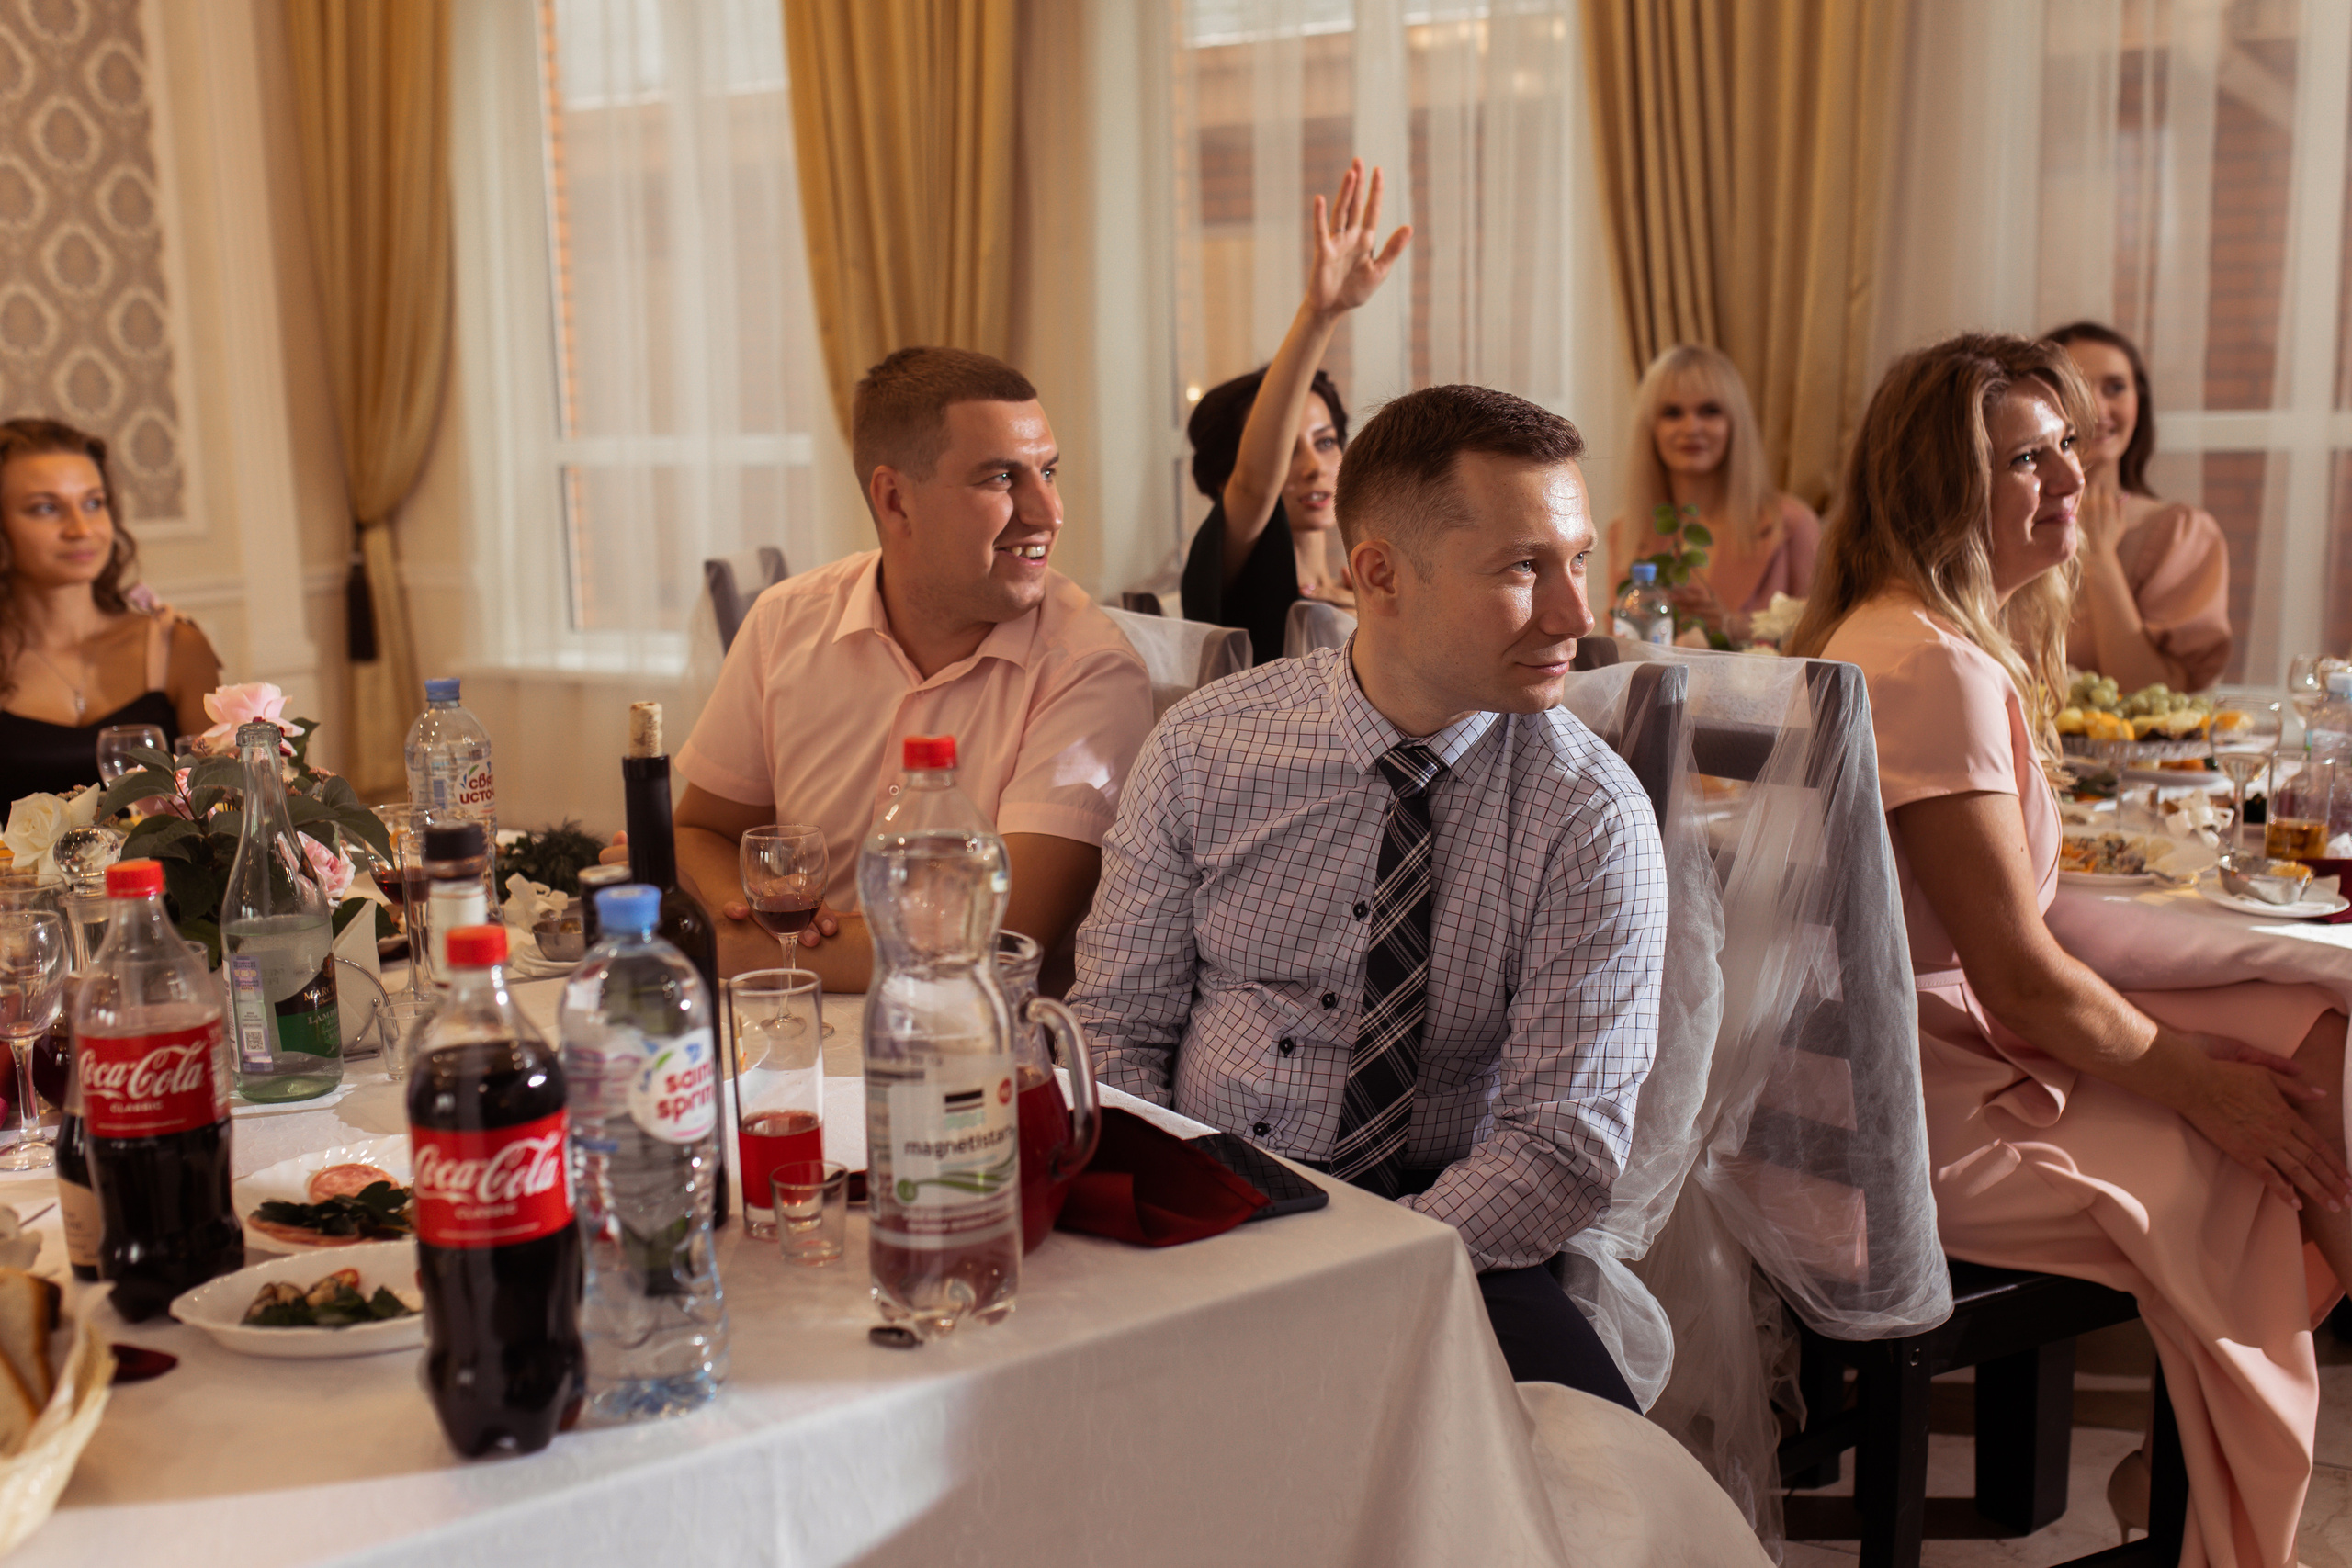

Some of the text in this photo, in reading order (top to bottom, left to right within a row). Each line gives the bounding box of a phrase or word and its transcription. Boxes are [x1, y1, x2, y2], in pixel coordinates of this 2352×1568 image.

[79, 1039, 208, 1100] Coca-Cola
[657, 1084, 716, 1124] sprin
[414, 1131, 563, 1205] Coca-Cola
